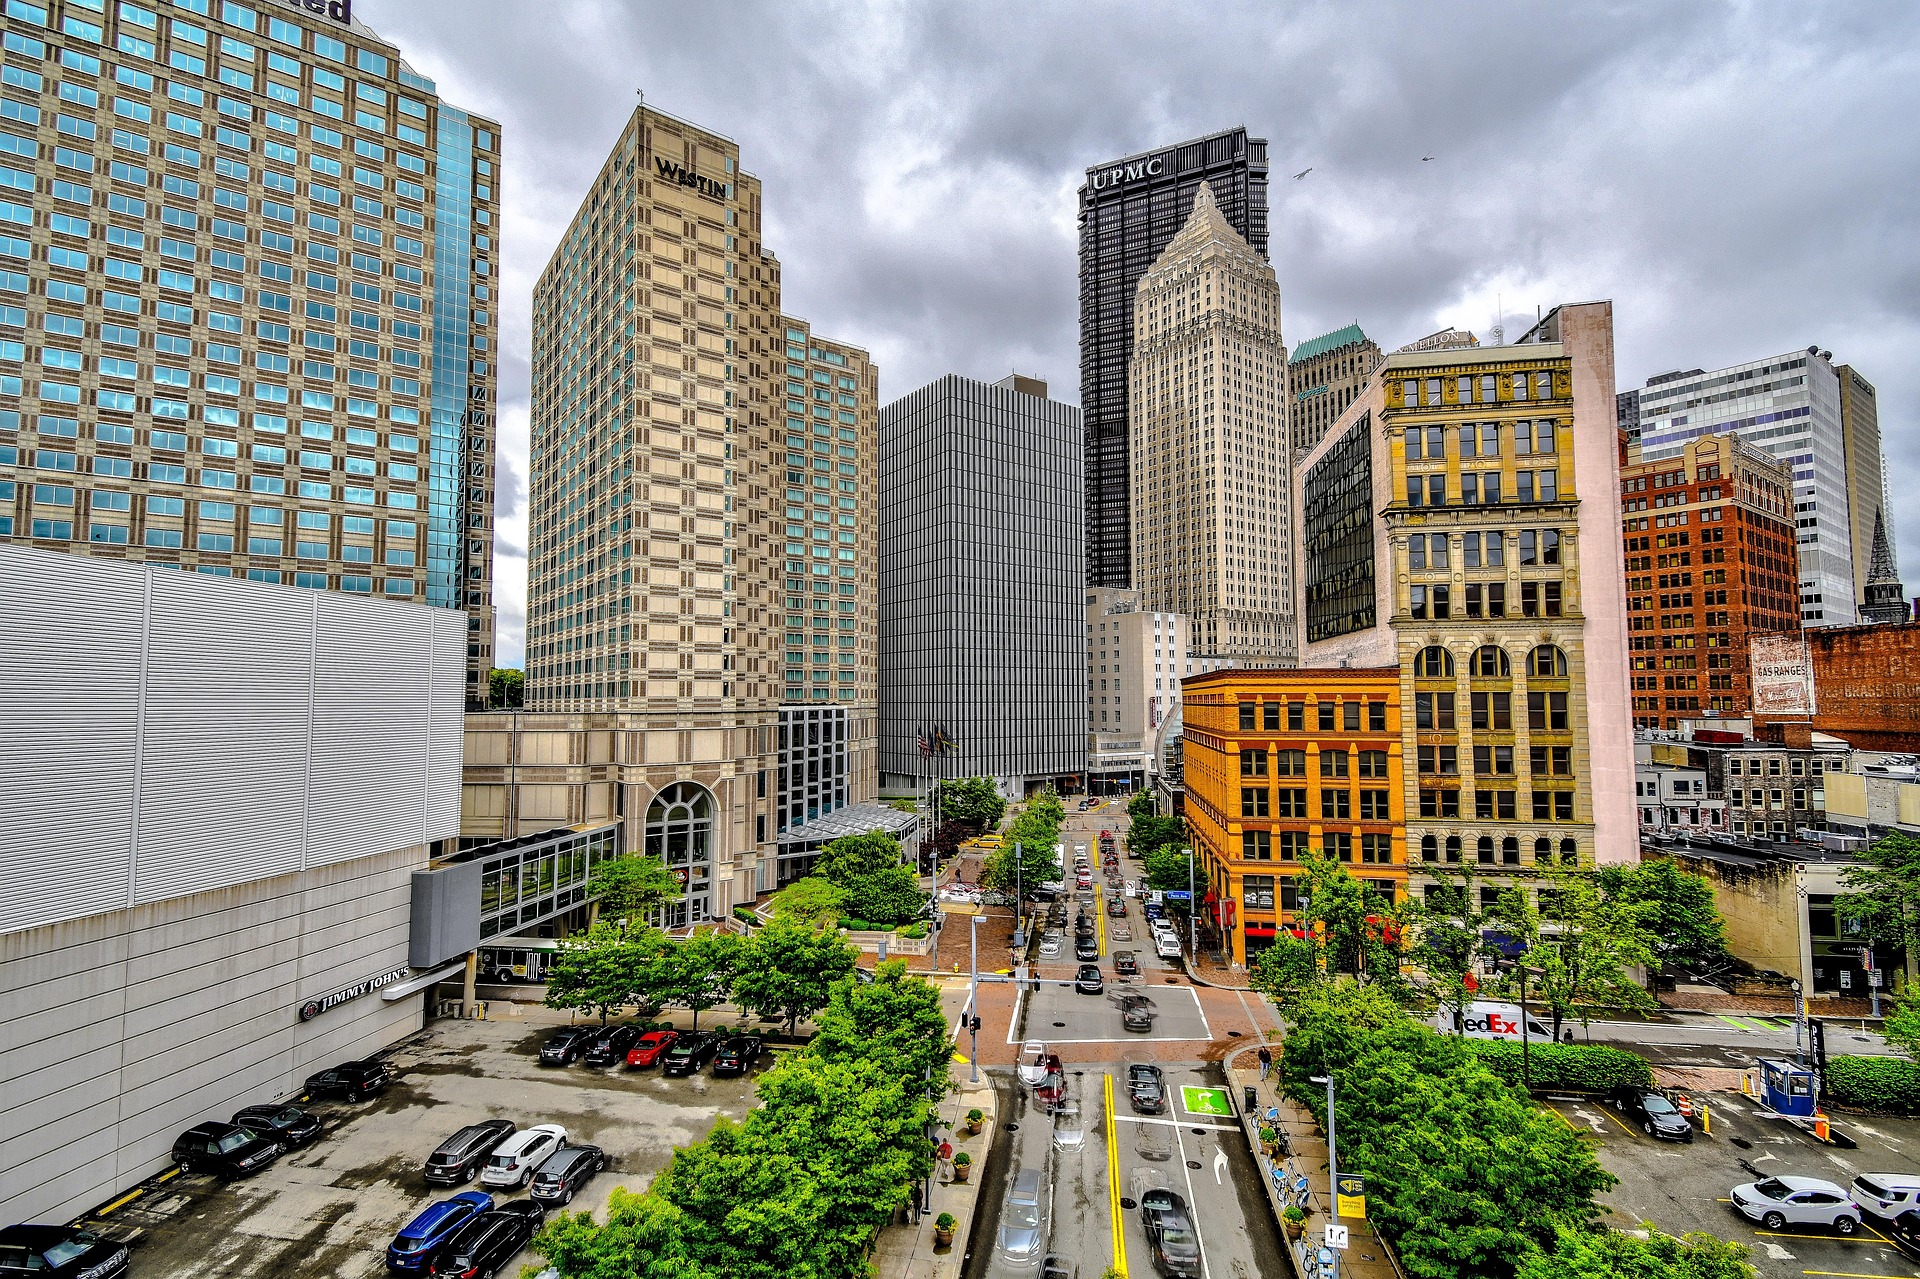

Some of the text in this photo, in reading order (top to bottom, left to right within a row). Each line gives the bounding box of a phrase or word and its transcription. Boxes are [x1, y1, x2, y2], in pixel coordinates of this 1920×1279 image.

[654, 156, 726, 197] WESTIN
[1092, 158, 1162, 190] UPMC
[1408, 330, 1460, 352] MELLON
[1297, 384, 1329, 401] KOPPERS
[1757, 667, 1773, 677] GAS
[1774, 665, 1807, 677] RANGES
[321, 981, 368, 1012] JIMMY
[369, 966, 410, 992] JOHN'S
